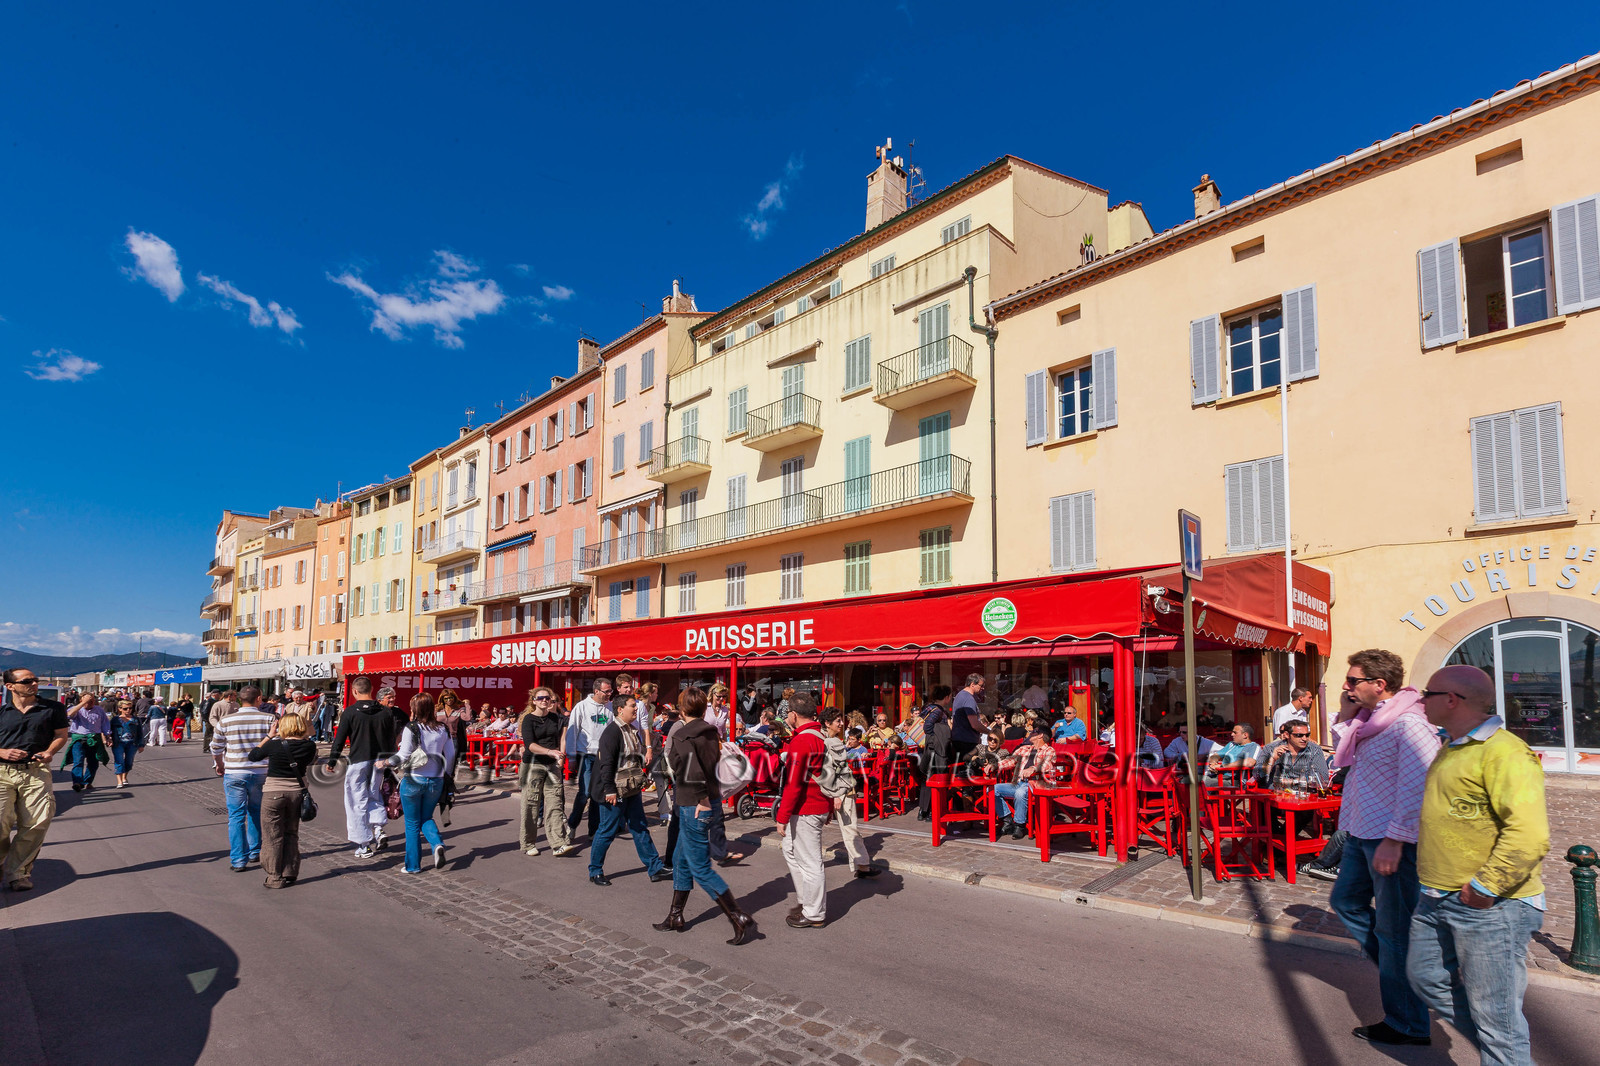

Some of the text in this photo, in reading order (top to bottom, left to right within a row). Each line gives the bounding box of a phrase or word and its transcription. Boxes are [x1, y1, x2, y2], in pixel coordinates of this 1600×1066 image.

[1462, 544, 1597, 573] OFFICE DE
[1400, 562, 1600, 630] TOURIS
[985, 612, 1014, 620] Heineken
[685, 618, 815, 652] PATISSERIE
[1234, 622, 1268, 644] SENEQUIER
[401, 650, 444, 668] TEA ROOM
[490, 635, 602, 666] SENEQUIER
